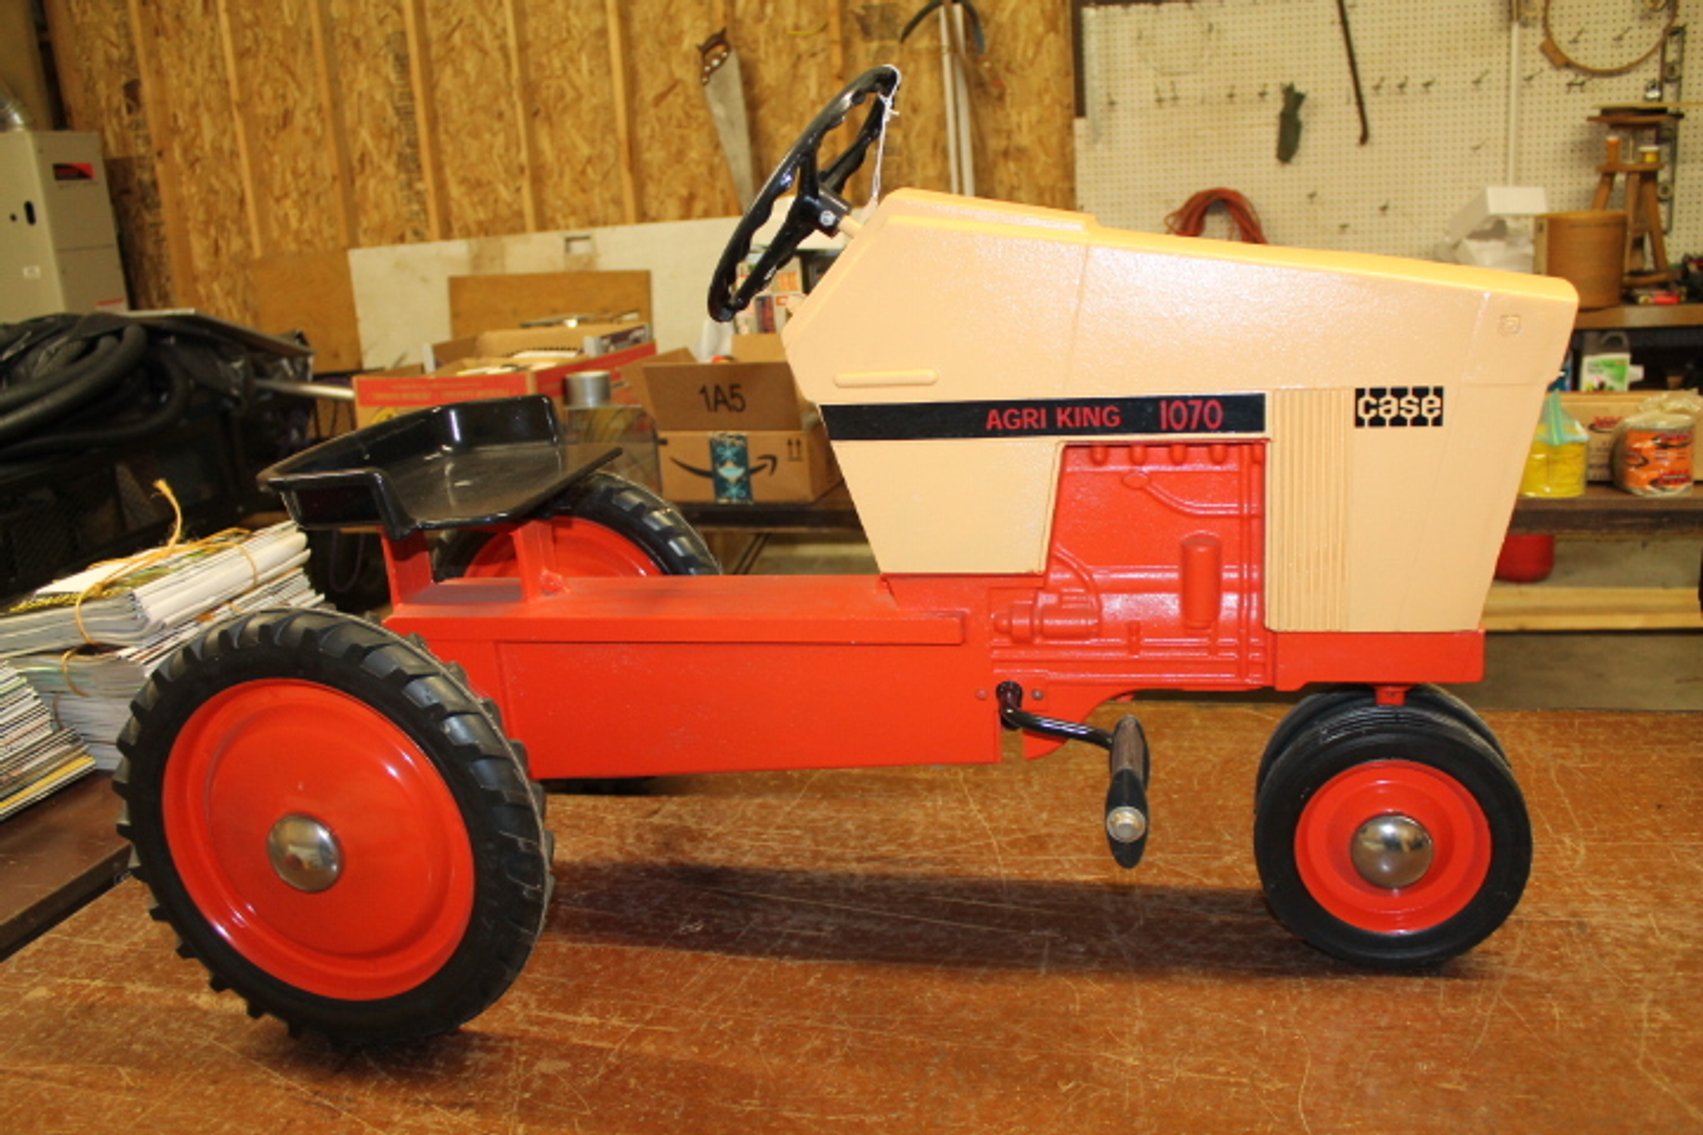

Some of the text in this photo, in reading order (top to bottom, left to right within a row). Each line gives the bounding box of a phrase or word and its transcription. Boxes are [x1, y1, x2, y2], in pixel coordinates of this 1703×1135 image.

[699, 384, 746, 413] 1A5
[1355, 388, 1442, 424] case
[985, 399, 1224, 431] AGRI KING 1070
